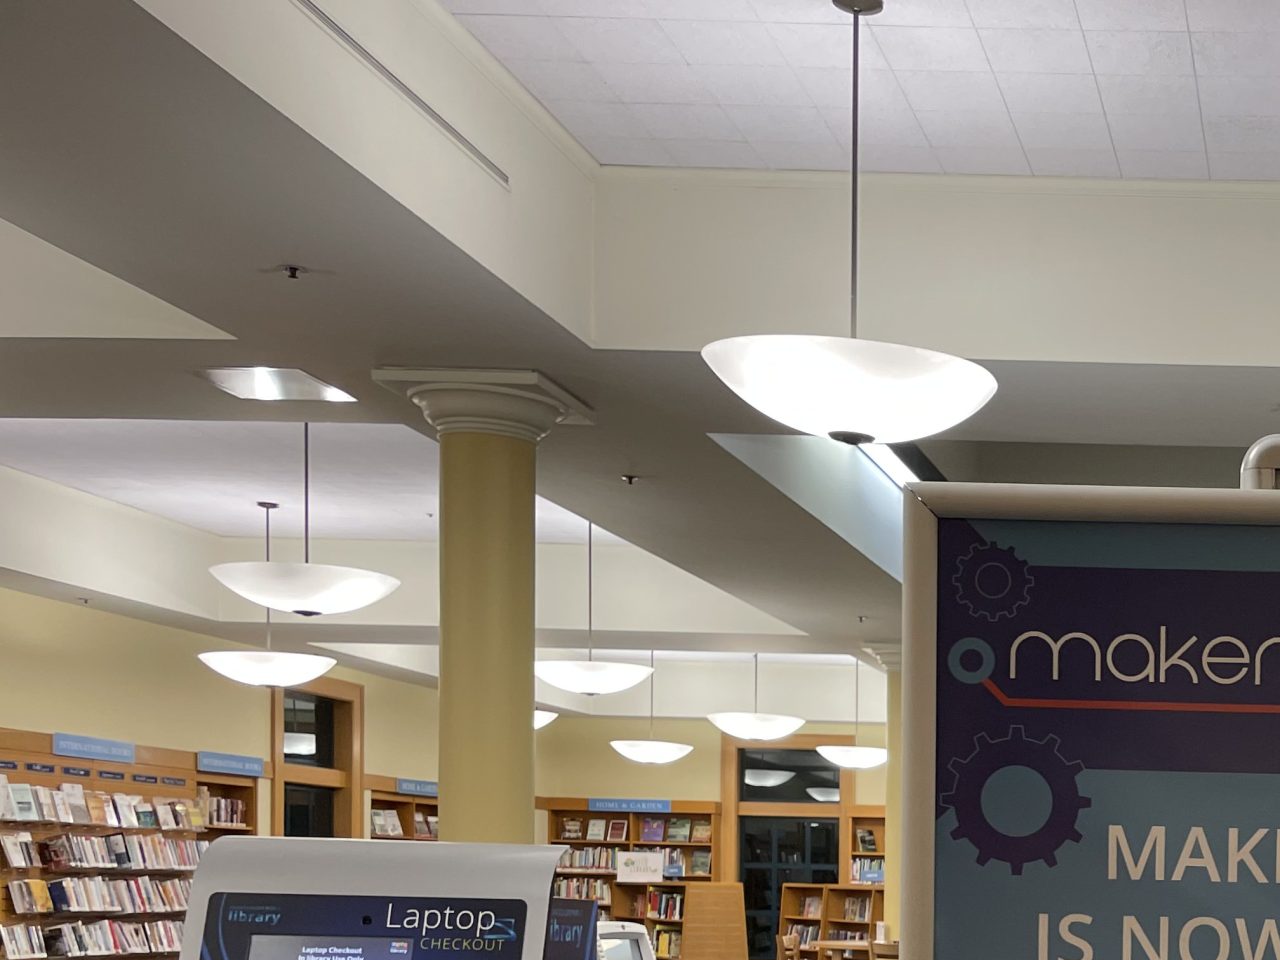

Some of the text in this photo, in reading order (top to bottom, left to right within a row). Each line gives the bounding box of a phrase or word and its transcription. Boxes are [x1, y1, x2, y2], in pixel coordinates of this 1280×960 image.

[228, 910, 281, 925] library
[386, 903, 495, 937] Laptop
[302, 946, 362, 955] Laptop Checkout
[420, 938, 504, 951] CHECKOUT
